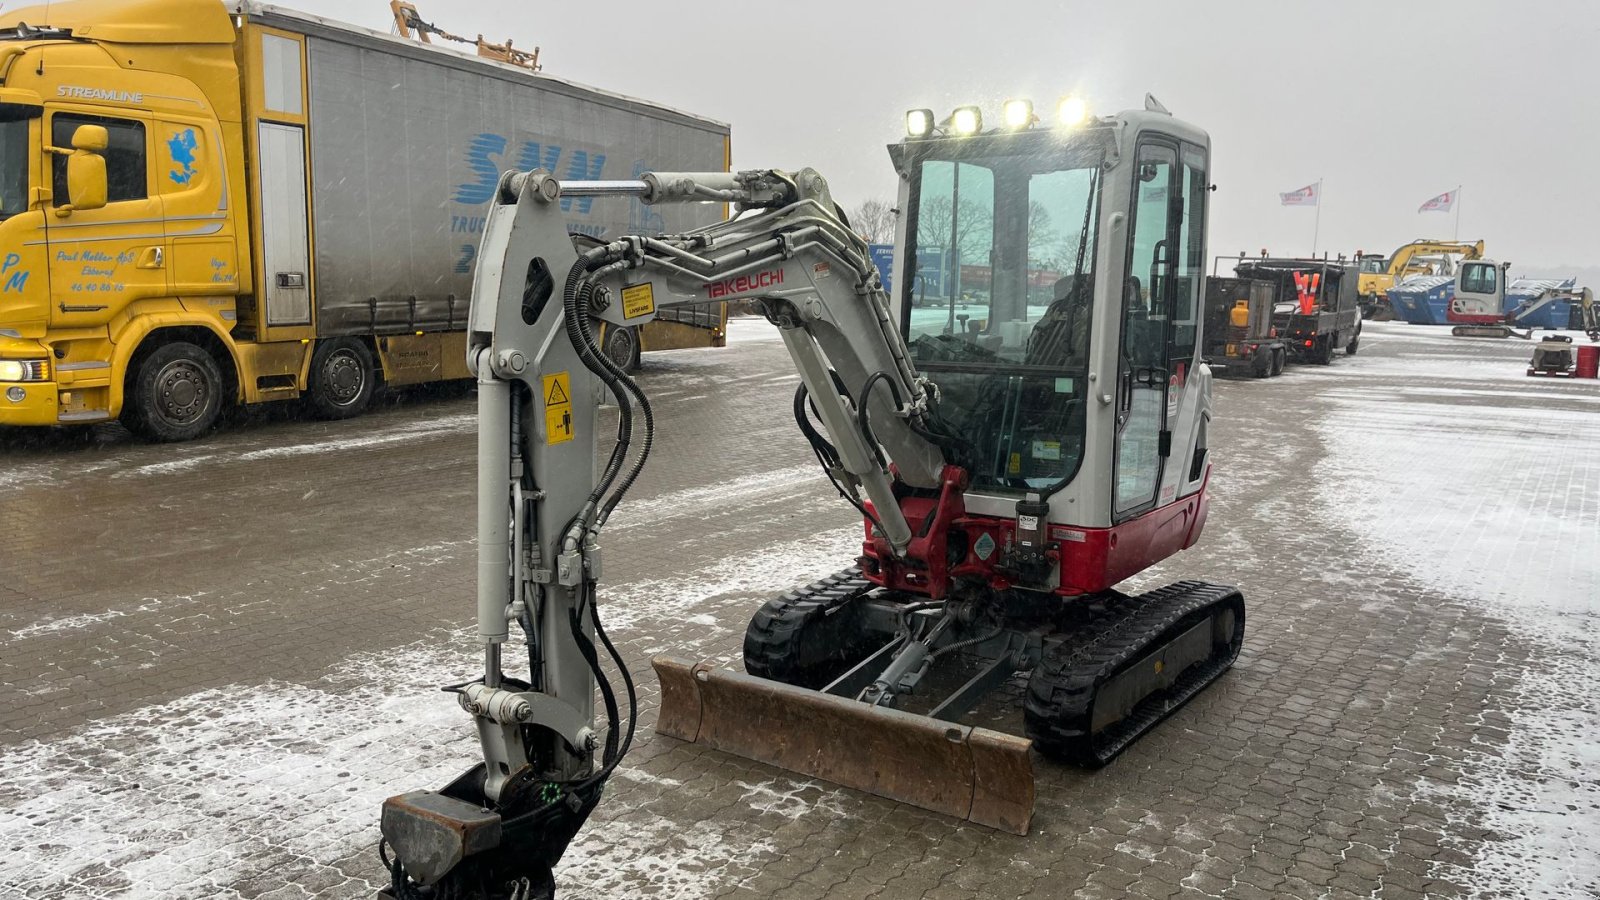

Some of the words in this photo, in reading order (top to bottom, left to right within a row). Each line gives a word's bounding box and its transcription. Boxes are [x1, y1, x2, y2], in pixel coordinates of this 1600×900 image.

[57, 85, 143, 103] STREAMLINE
[2, 253, 20, 273] P
[4, 271, 30, 292] M
